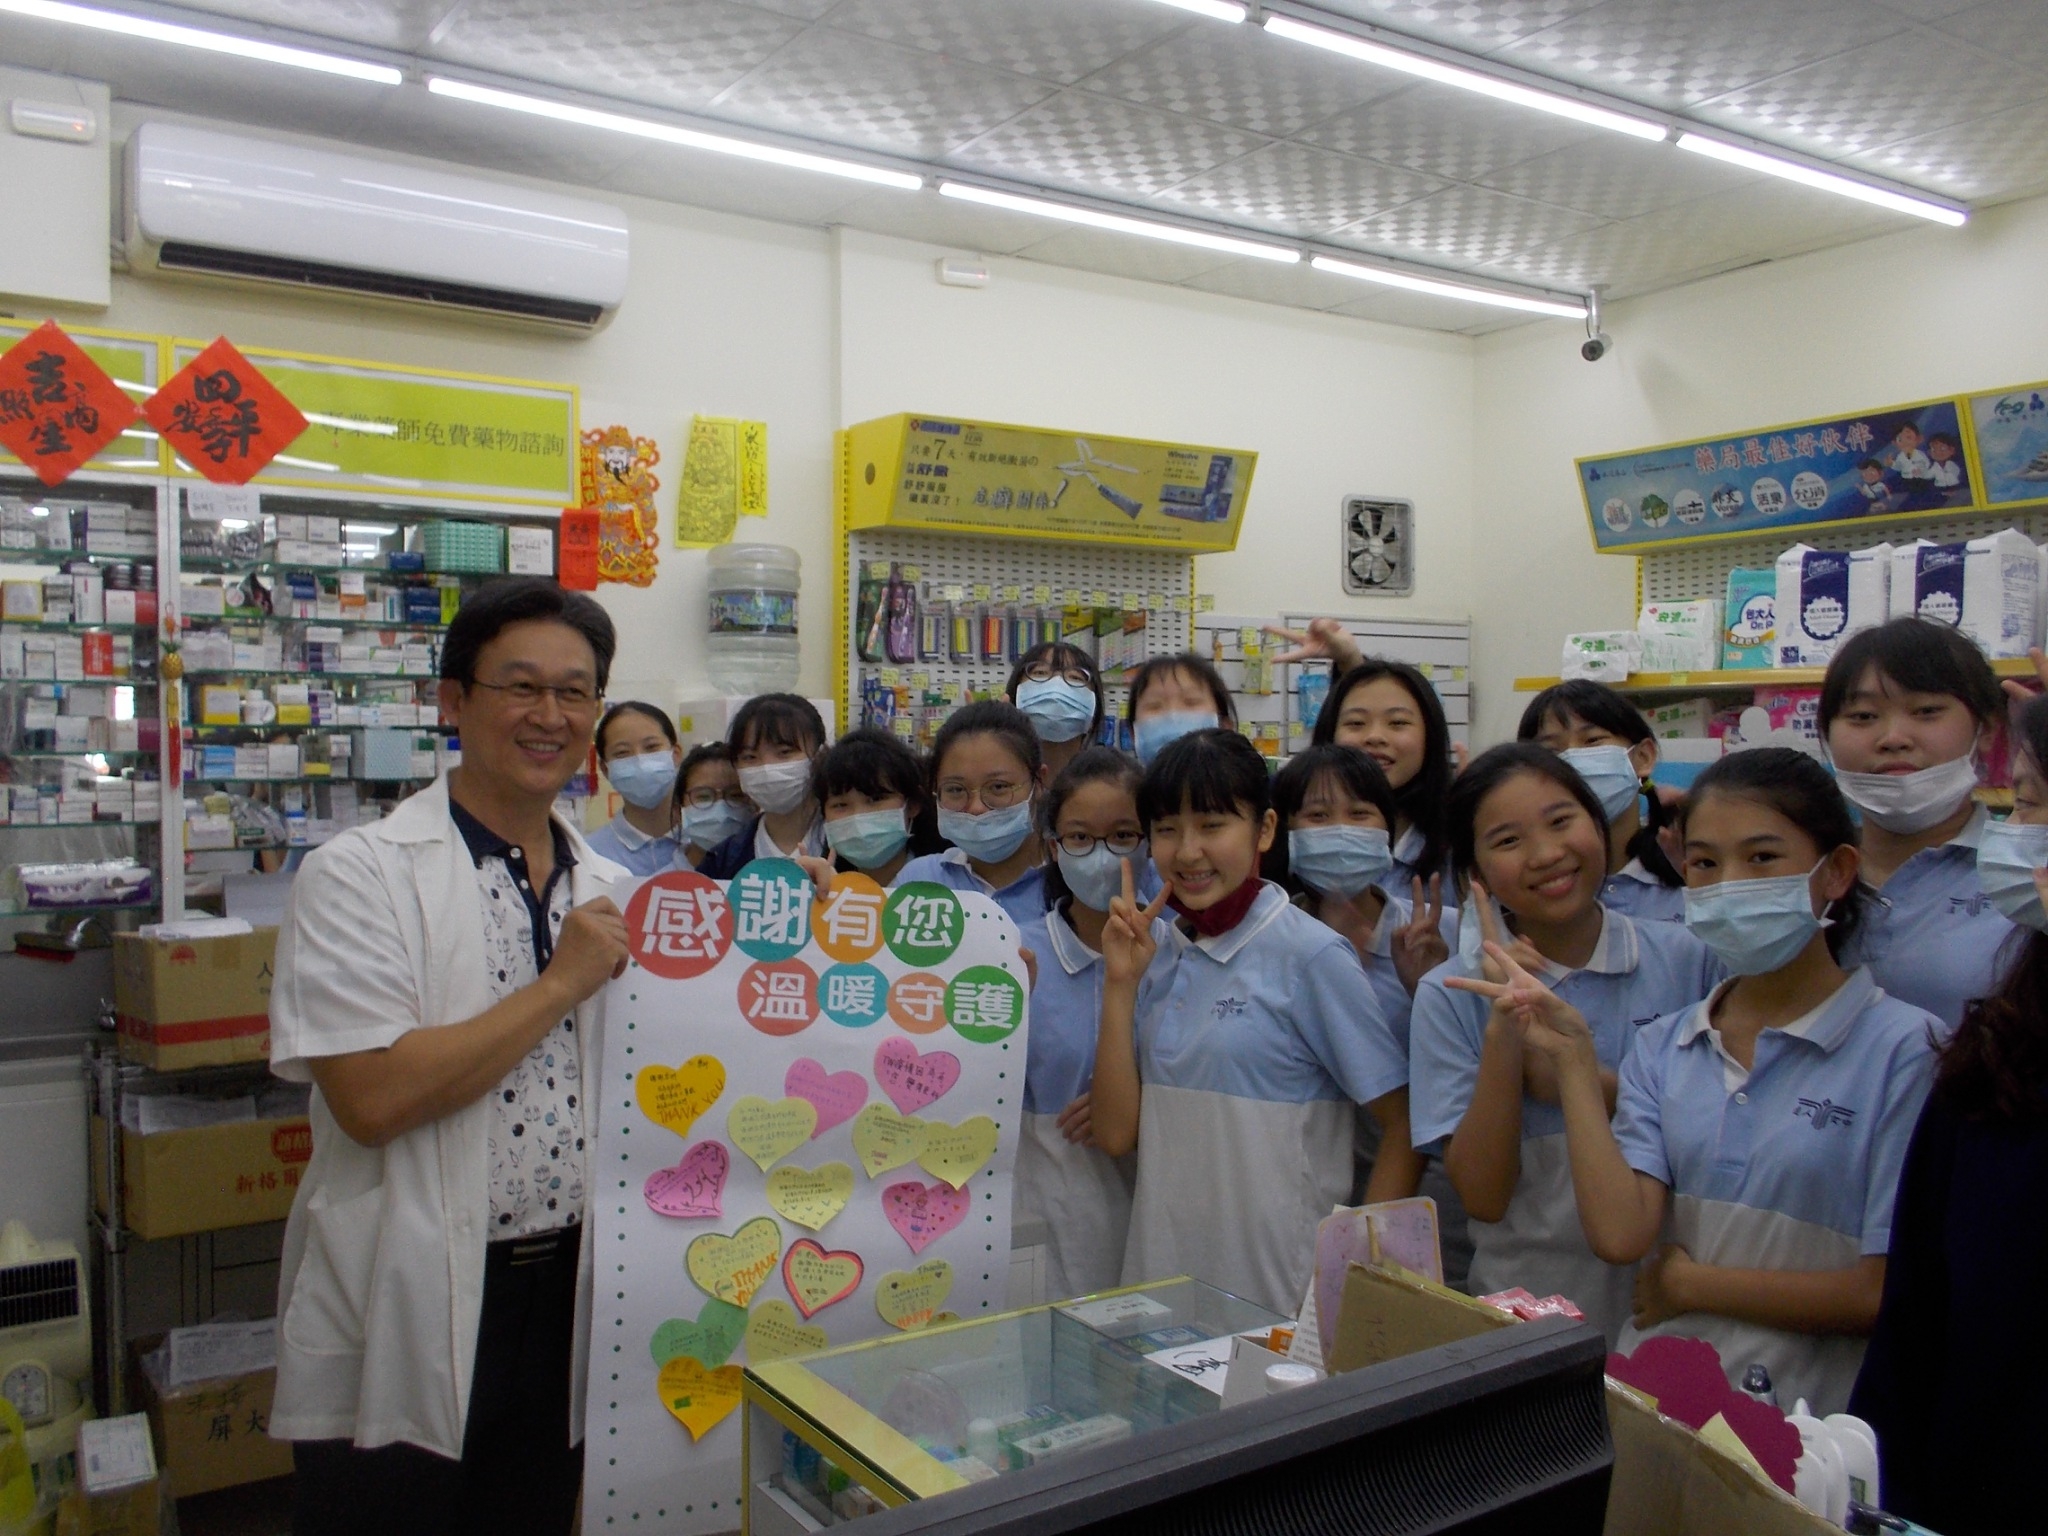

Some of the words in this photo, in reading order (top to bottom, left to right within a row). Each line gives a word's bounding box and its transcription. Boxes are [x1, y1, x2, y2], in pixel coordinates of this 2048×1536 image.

[1694, 421, 1874, 475] 藥局最佳好伙伴
[641, 873, 956, 959] 感謝有您
[749, 969, 1014, 1030] 溫暖守護
